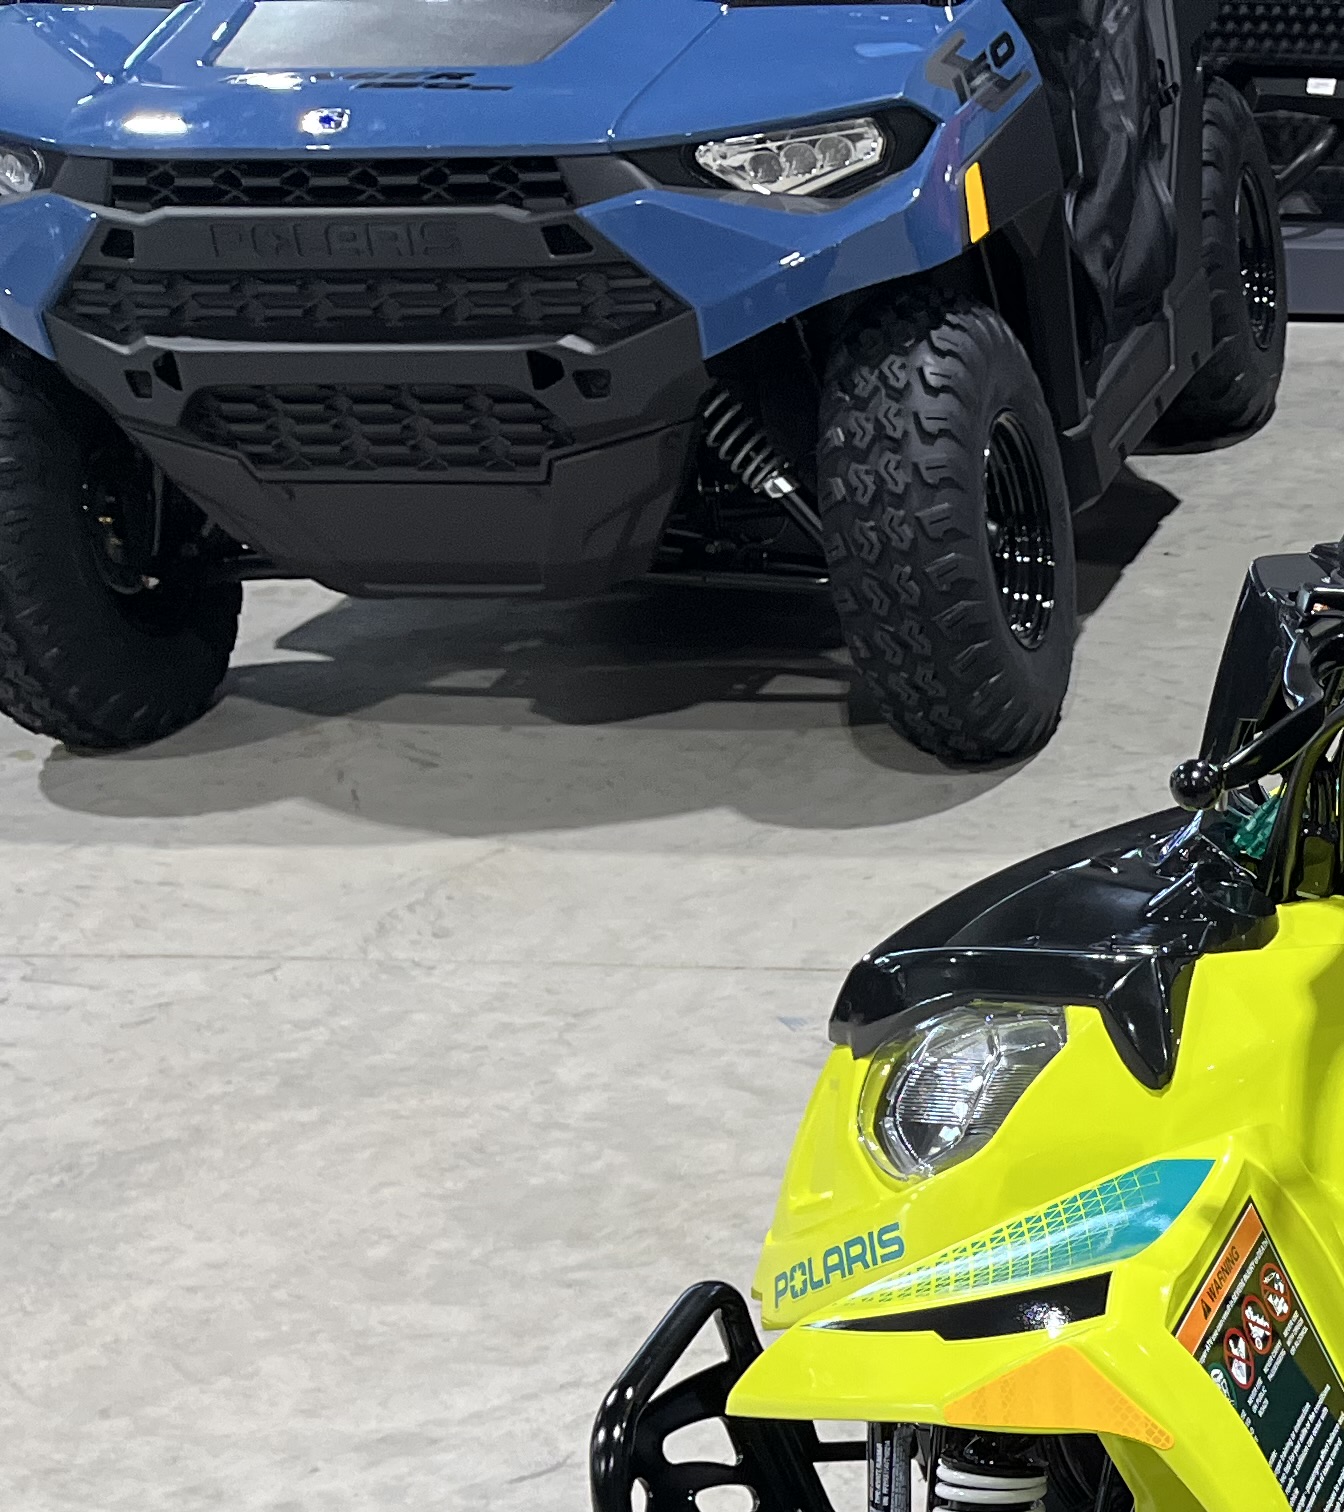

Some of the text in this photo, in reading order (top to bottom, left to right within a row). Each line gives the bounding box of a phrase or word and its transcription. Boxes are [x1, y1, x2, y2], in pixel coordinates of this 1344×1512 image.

[209, 221, 459, 258] POLARIS
[774, 1221, 906, 1309] POLARIS
[1205, 1241, 1240, 1306] WARNING
